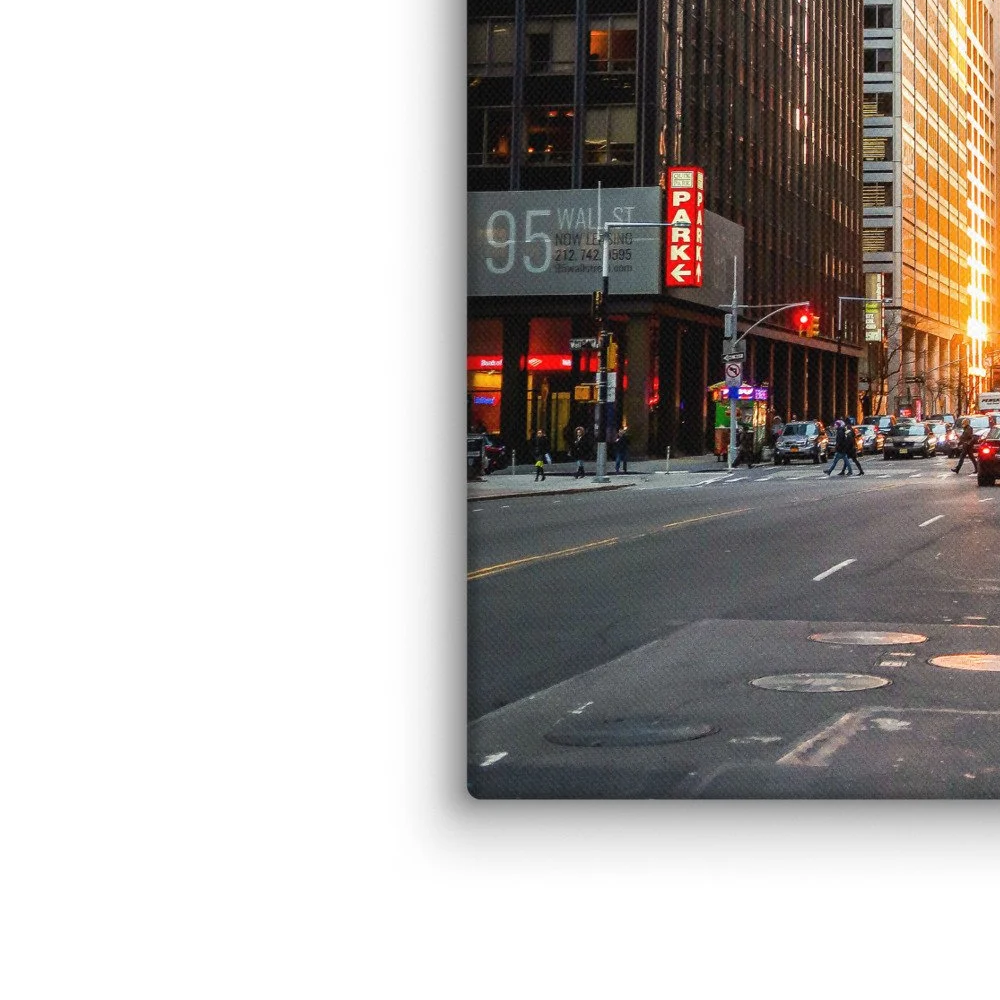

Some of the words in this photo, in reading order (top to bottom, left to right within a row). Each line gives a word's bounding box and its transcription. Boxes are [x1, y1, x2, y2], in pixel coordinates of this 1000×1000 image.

[555, 232, 581, 246] NOW
[585, 231, 633, 246] LESING
[557, 207, 605, 230] WAL
[670, 191, 692, 261] PARK
[485, 210, 551, 274] 95
